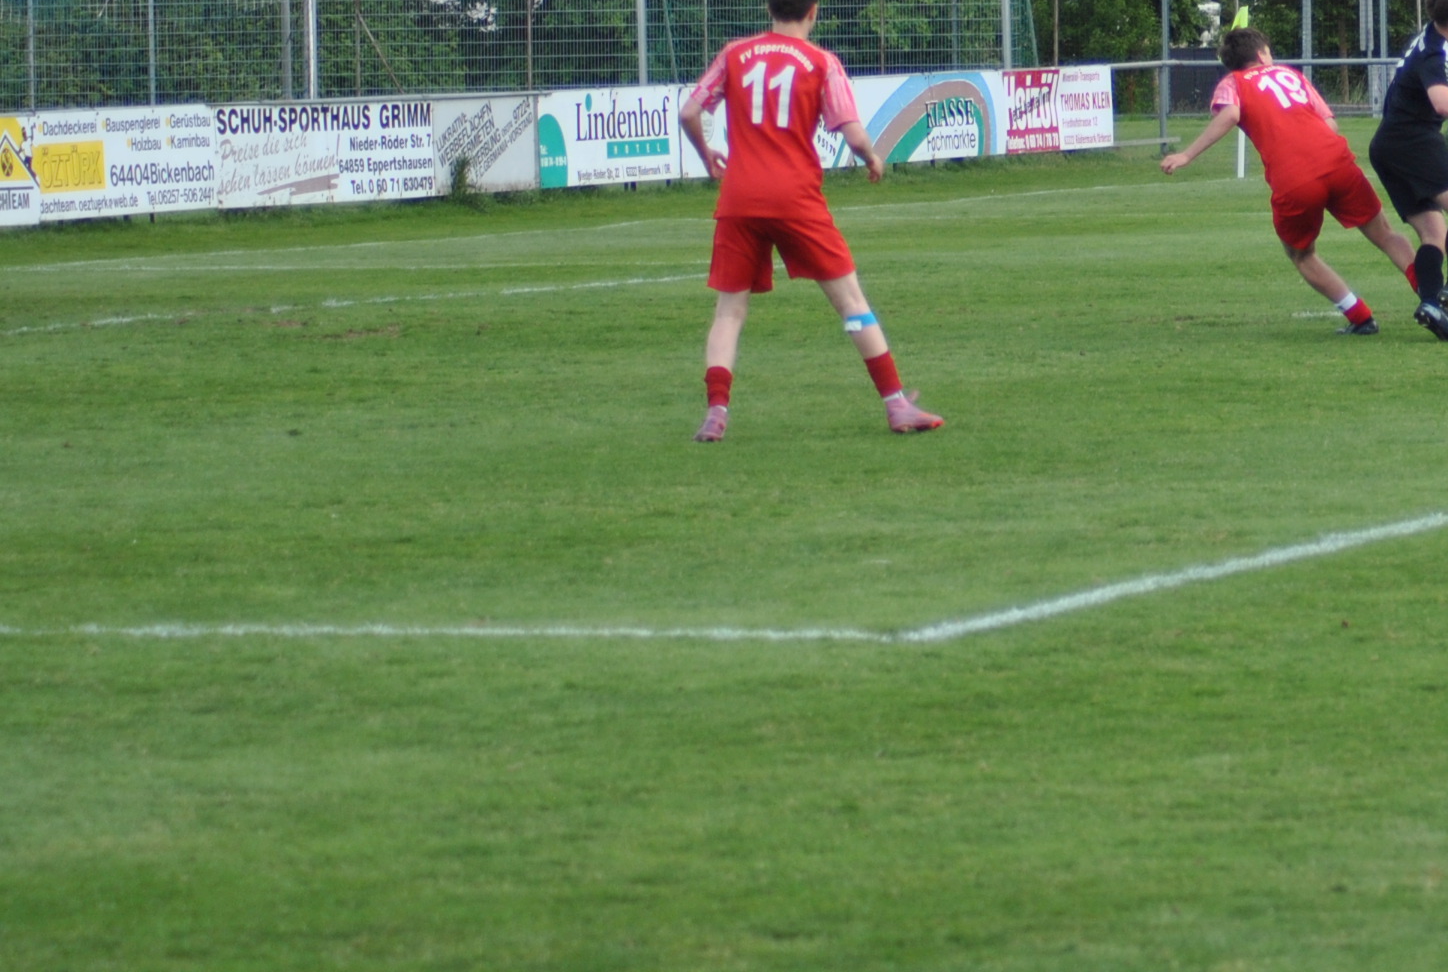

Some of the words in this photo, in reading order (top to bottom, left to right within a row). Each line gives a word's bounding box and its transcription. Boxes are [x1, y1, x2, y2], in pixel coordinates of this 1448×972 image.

[742, 61, 796, 128] 11
[1060, 92, 1089, 111] THOMAS
[1092, 91, 1110, 109] KLEIN
[1257, 71, 1309, 108] 19
[42, 118, 97, 136] Dachdeckerei
[105, 115, 160, 134] Bauspenglerei
[169, 113, 211, 129] Gerüstbau
[216, 105, 371, 135] SCHUH-SPORTHAUS
[379, 103, 431, 129] GRIMM
[575, 93, 670, 141] Lindenhof
[925, 98, 974, 129] KLASSE
[131, 136, 161, 151] Holzbau
[170, 133, 210, 149] Kaminbau
[349, 135, 408, 151] Nieder-Röder
[410, 133, 425, 148] Str.
[426, 133, 431, 147] 7
[436, 113, 467, 153] LUKRATIVE
[439, 100, 492, 168] WERBEFLÄCHEN
[927, 129, 976, 152] Fachmärkte
[220, 138, 259, 168] Preise
[263, 134, 280, 156] die
[284, 131, 307, 152] sich
[339, 158, 364, 174] 64859
[367, 156, 433, 175] Eppertshausen
[42, 145, 102, 188] ÖZTÜRK
[217, 168, 250, 196] sehen
[255, 164, 290, 187] lassen
[351, 179, 367, 194] Tel.
[369, 178, 374, 194] 0
[376, 178, 388, 194] 60
